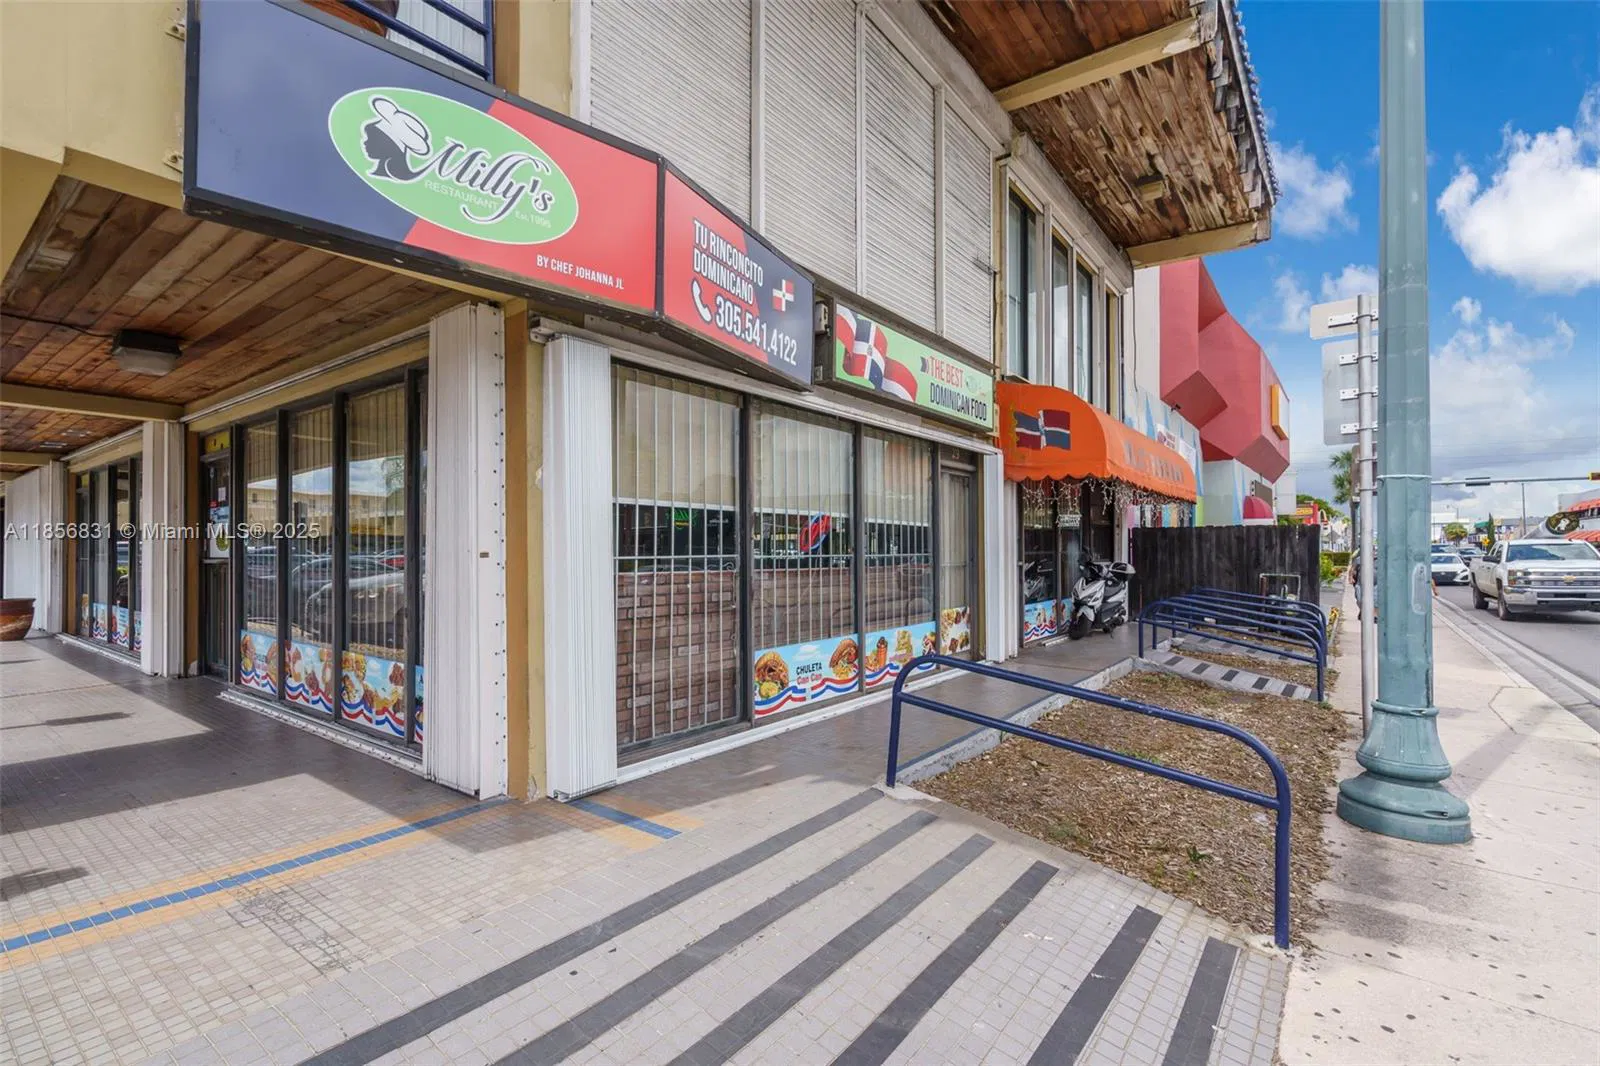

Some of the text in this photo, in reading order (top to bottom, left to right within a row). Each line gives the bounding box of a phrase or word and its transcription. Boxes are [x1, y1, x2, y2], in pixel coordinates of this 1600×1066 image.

[424, 180, 499, 210] RESTAURANT
[427, 137, 555, 224] Milly's
[536, 254, 625, 290] BY CHEF JOHANNA JL
[693, 220, 764, 287] TU RINCONCITO
[693, 248, 754, 304] DOMINICANO
[715, 294, 797, 366] 305.541.4122
[929, 355, 945, 381] THE
[946, 363, 963, 388] BEST
[930, 382, 969, 415] DOMINICAN
[970, 398, 987, 421] FOOD
[796, 661, 823, 676] CHULETA
